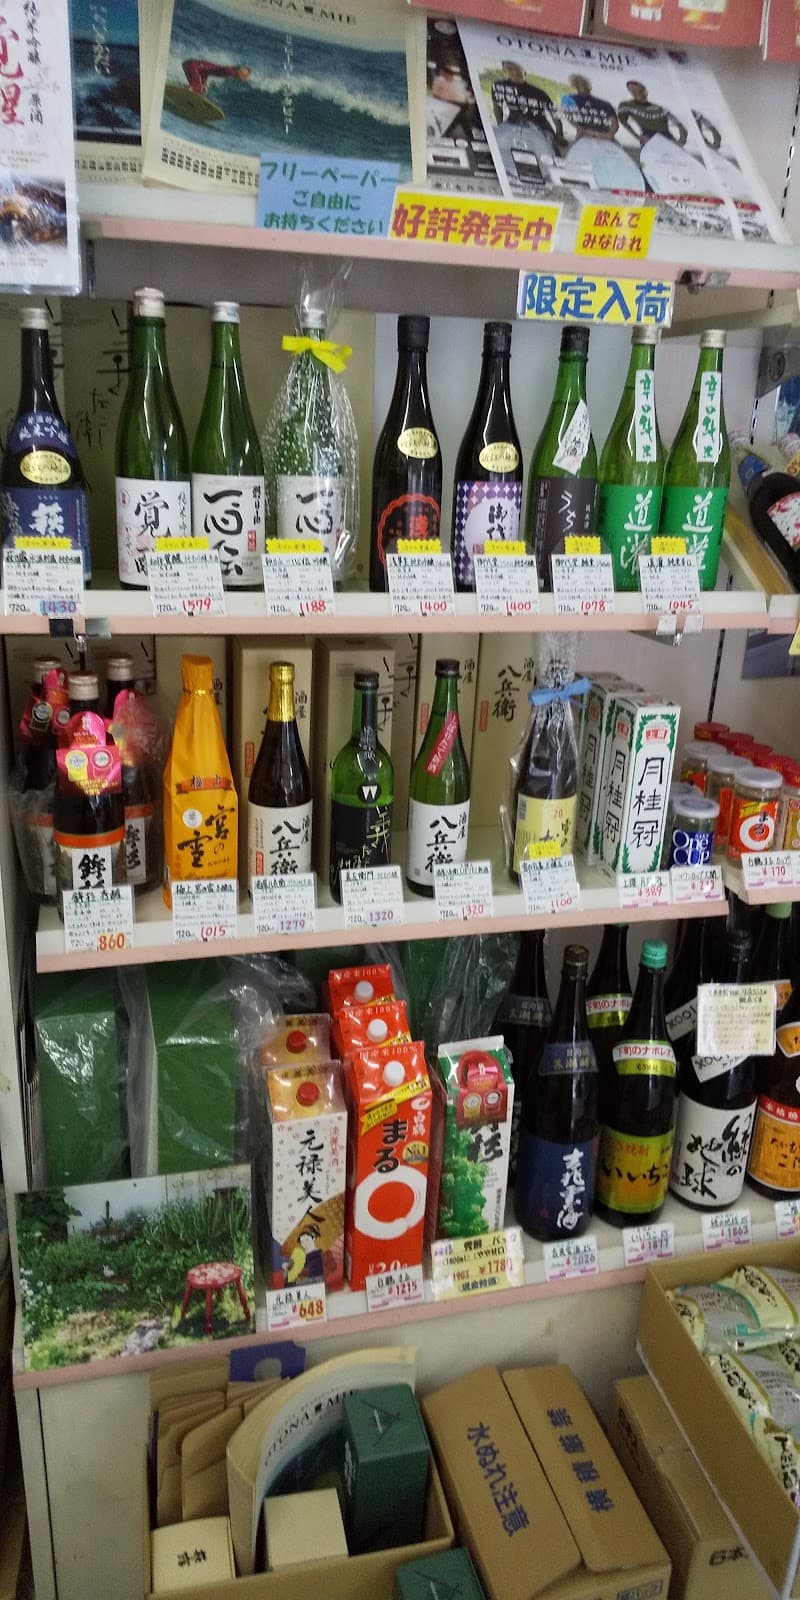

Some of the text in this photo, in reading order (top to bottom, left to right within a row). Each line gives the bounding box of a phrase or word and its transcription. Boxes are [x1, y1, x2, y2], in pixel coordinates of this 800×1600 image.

[261, 159, 402, 186] フリーペーパー
[291, 190, 361, 211] ご自由に
[262, 213, 384, 235] お持ちください
[391, 203, 554, 252] 好評発売中
[593, 209, 641, 229] 飲んで
[582, 233, 643, 252] みなはれ
[521, 272, 672, 325] 限定入荷
[41, 600, 76, 613] 1430
[182, 597, 211, 611] 1579
[300, 600, 326, 613] 1188
[420, 601, 447, 612] 1400
[506, 601, 532, 612] 1400
[580, 600, 606, 612] 1078
[669, 600, 694, 610] 1045
[492, 663, 521, 722] 八兵衛
[604, 750, 626, 844] 月桂冠
[630, 756, 665, 849] 月桂冠
[369, 910, 394, 922] 1320
[462, 903, 484, 917] 1320
[201, 925, 226, 938] 1015
[99, 932, 125, 951] 860
[372, 1119, 408, 1174] まる
[295, 1129, 326, 1223] 元禄美人
[467, 1421, 530, 1537] 水ぬれ注意
